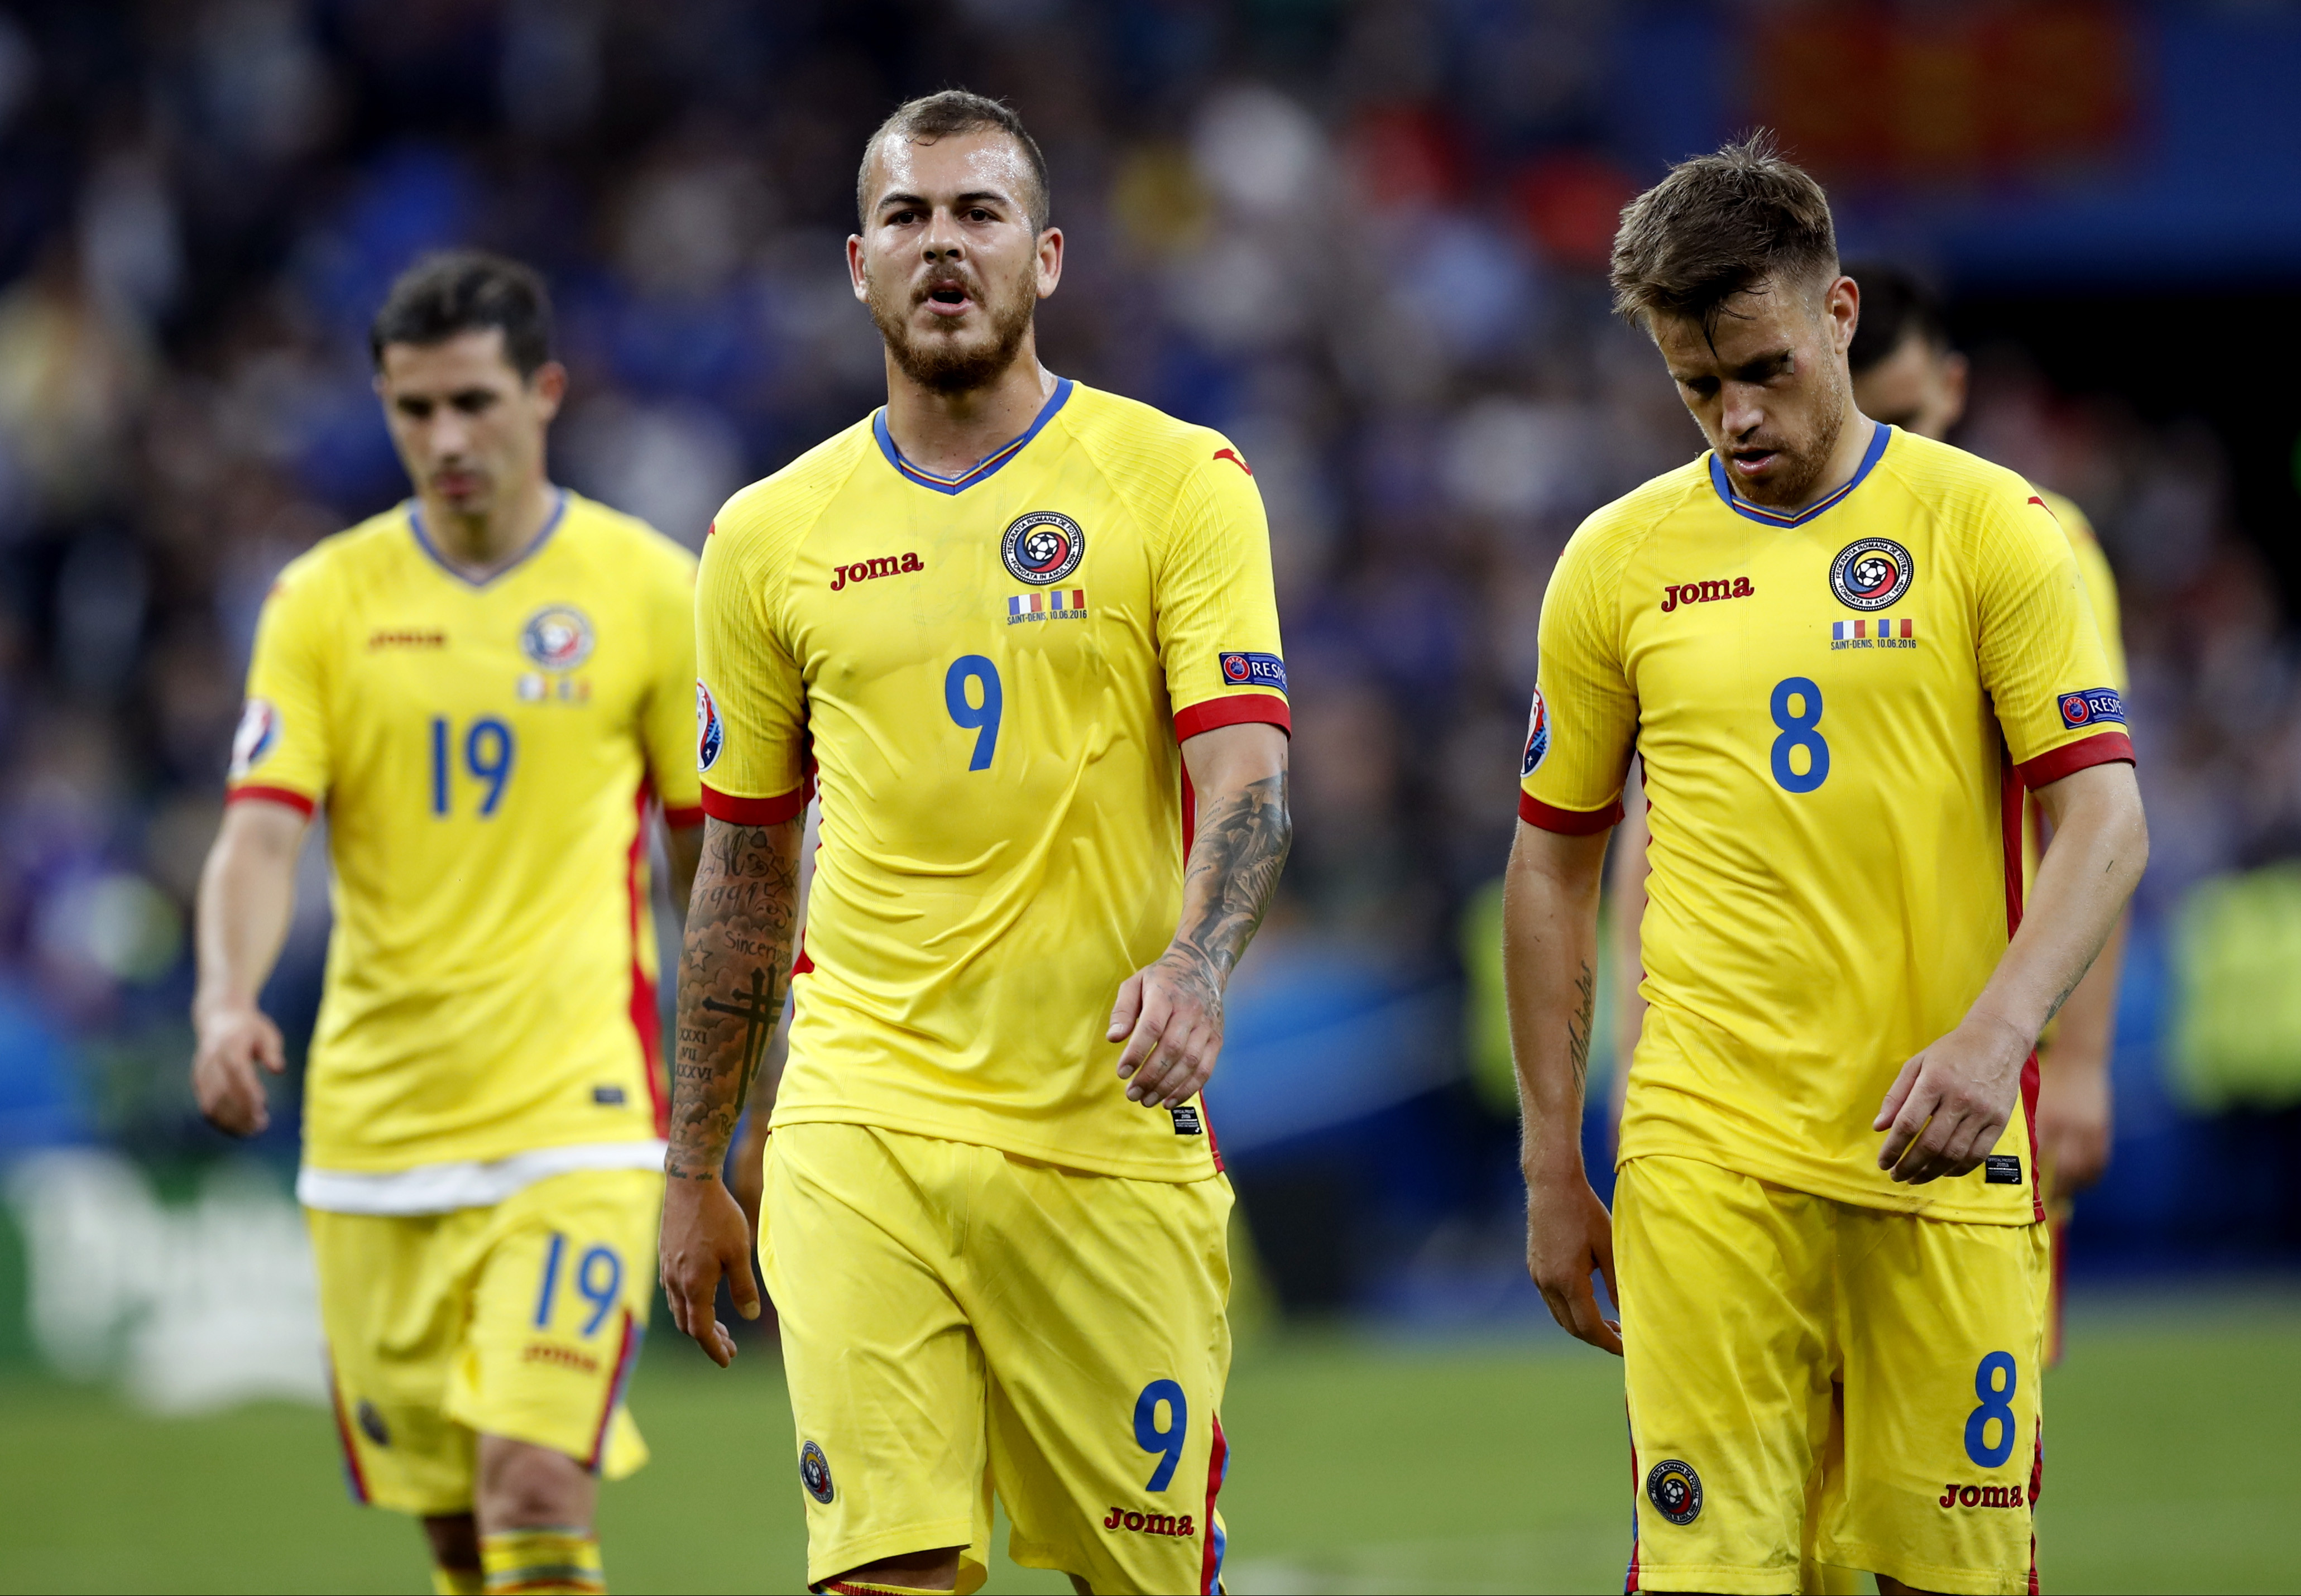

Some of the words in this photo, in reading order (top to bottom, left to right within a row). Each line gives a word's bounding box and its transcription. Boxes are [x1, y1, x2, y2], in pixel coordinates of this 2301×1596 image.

[1008, 523, 1027, 554] FEDERATIA
[1027, 516, 1057, 525] ROMANA
[1066, 525, 1078, 547] FOTBAL
[1012, 560, 1038, 579] FONDATA
[1049, 567, 1067, 578] ANUL
[1065, 554, 1075, 567] 1909
[1836, 548, 1858, 579] FEDERATIA
[1858, 542, 1888, 552] ROMANA
[1888, 547, 1897, 555] DE
[1896, 552, 1907, 576] FOTBAL
[1839, 586, 1863, 606] FONDATA
[1875, 594, 1893, 605] ANUL
[1892, 581, 1903, 596] 1909
[1008, 611, 1048, 625] SAINT-DENIS,
[1050, 610, 1087, 620] 10.06.2016
[1831, 639, 1875, 650] SAINT-DENIS,
[1877, 639, 1916, 648] 10.06.2016
[945, 654, 1002, 771] 9
[2067, 698, 2081, 706] UEFA
[1770, 677, 1829, 793] 8
[432, 718, 514, 816] 19
[682, 1047, 697, 1061] VII
[535, 1233, 623, 1336] 19
[1964, 1351, 2016, 1468] 8
[1133, 1379, 1187, 1491] 9
[1939, 1484, 2023, 1508] Joma
[1104, 1507, 1194, 1536] Joma
